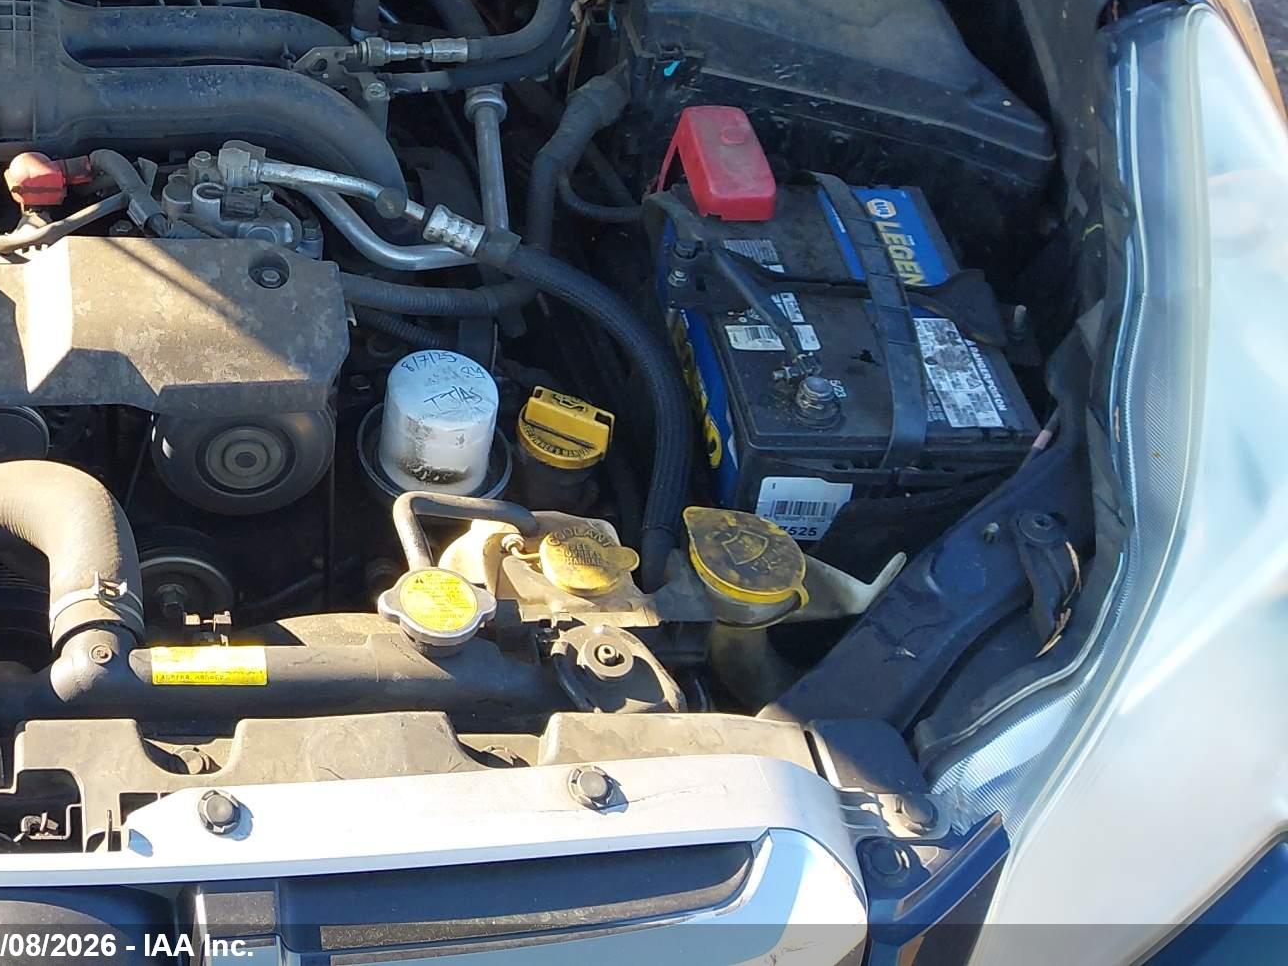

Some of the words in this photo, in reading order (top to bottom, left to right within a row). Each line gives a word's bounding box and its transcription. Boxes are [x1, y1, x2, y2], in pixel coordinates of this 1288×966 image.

[875, 221, 926, 286] LEGEN
[401, 351, 458, 373] 8/7/25
[546, 526, 616, 548] COOLANT
[565, 557, 601, 566] MANUAL
